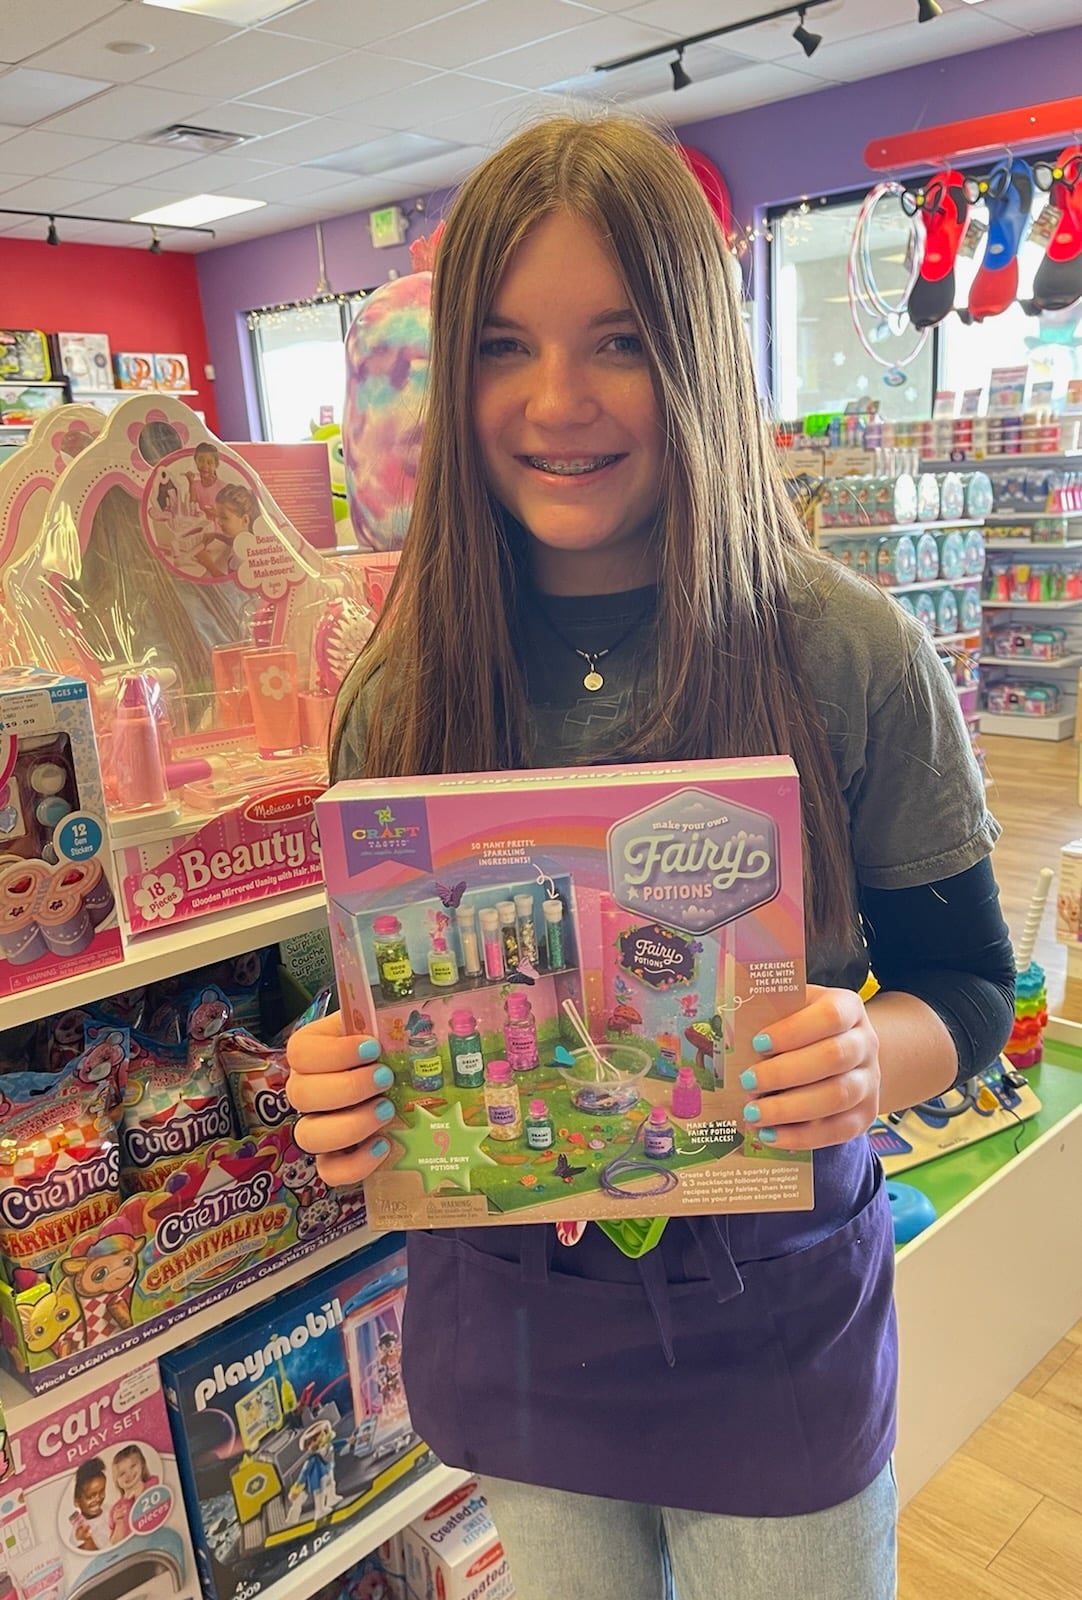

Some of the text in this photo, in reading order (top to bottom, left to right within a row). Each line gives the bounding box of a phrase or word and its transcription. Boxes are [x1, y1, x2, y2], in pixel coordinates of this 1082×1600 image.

[253, 565, 296, 579] Makeovers!
[51, 687, 84, 699] AGES 4+
[253, 803, 293, 818] Melissa
[71, 823, 88, 838] 12
[652, 815, 729, 834] make your own
[351, 825, 421, 841] CRAFT
[74, 837, 88, 846] Gem
[471, 839, 537, 850] SO MANY PRETTY,
[70, 845, 94, 857] Stickers
[482, 848, 526, 858] SPARKLING
[179, 829, 307, 893] Beauty
[478, 857, 532, 867] INGREDIENTS!
[623, 832, 771, 890] Fairy
[148, 881, 166, 900] 18
[191, 892, 222, 909] Wooden
[221, 881, 256, 901] Mirrored
[254, 875, 278, 892] Vanity
[277, 869, 293, 882] with
[643, 883, 714, 901] POTIONS
[148, 890, 178, 914] Pieces
[286, 929, 325, 956] Surprise!
[291, 946, 326, 969] Couche
[635, 938, 684, 966] Fairy
[633, 955, 664, 969] POTIONS
[749, 960, 795, 971] EXPERIENCE
[749, 968, 796, 979] MAGIC WITH
[755, 976, 793, 987] THE FAIRY
[749, 984, 800, 995] POTION BOOK
[429, 1122, 451, 1130] MAKE
[686, 1121, 708, 1130] MAKE
[715, 1119, 738, 1128] WEAR
[687, 1127, 738, 1137] FAIRY POTION
[432, 1130, 451, 1158] 9
[690, 1135, 735, 1145] NECKLACES!
[418, 1155, 470, 1165] MAGICAL FAIRY
[430, 1162, 461, 1172] POTIONS
[680, 1171, 704, 1179] Create
[704, 1170, 712, 1178] 6
[712, 1169, 735, 1179] bright
[743, 1167, 770, 1178] sparkly
[771, 1166, 800, 1176] potions
[689, 1178, 696, 1187] 3
[696, 1178, 733, 1187] necklaces
[734, 1176, 768, 1186] following
[769, 1175, 799, 1183] magical
[683, 1188, 711, 1197] recipes
[711, 1187, 724, 1195] left
[725, 1186, 734, 1195] by
[761, 1184, 778, 1192] then
[779, 1183, 798, 1193] keep
[710, 1195, 728, 1204] your
[728, 1194, 753, 1204] potion
[754, 1192, 782, 1202] storage
[194, 1297, 343, 1413] playmobil
[34, 1374, 67, 1394] WHICH
[66, 1407, 142, 1463] PLAY SET
[140, 1490, 162, 1511] 20
[138, 1504, 170, 1529] pieces
[430, 1505, 473, 1543] Created
[287, 1530, 332, 1569] 24 pc
